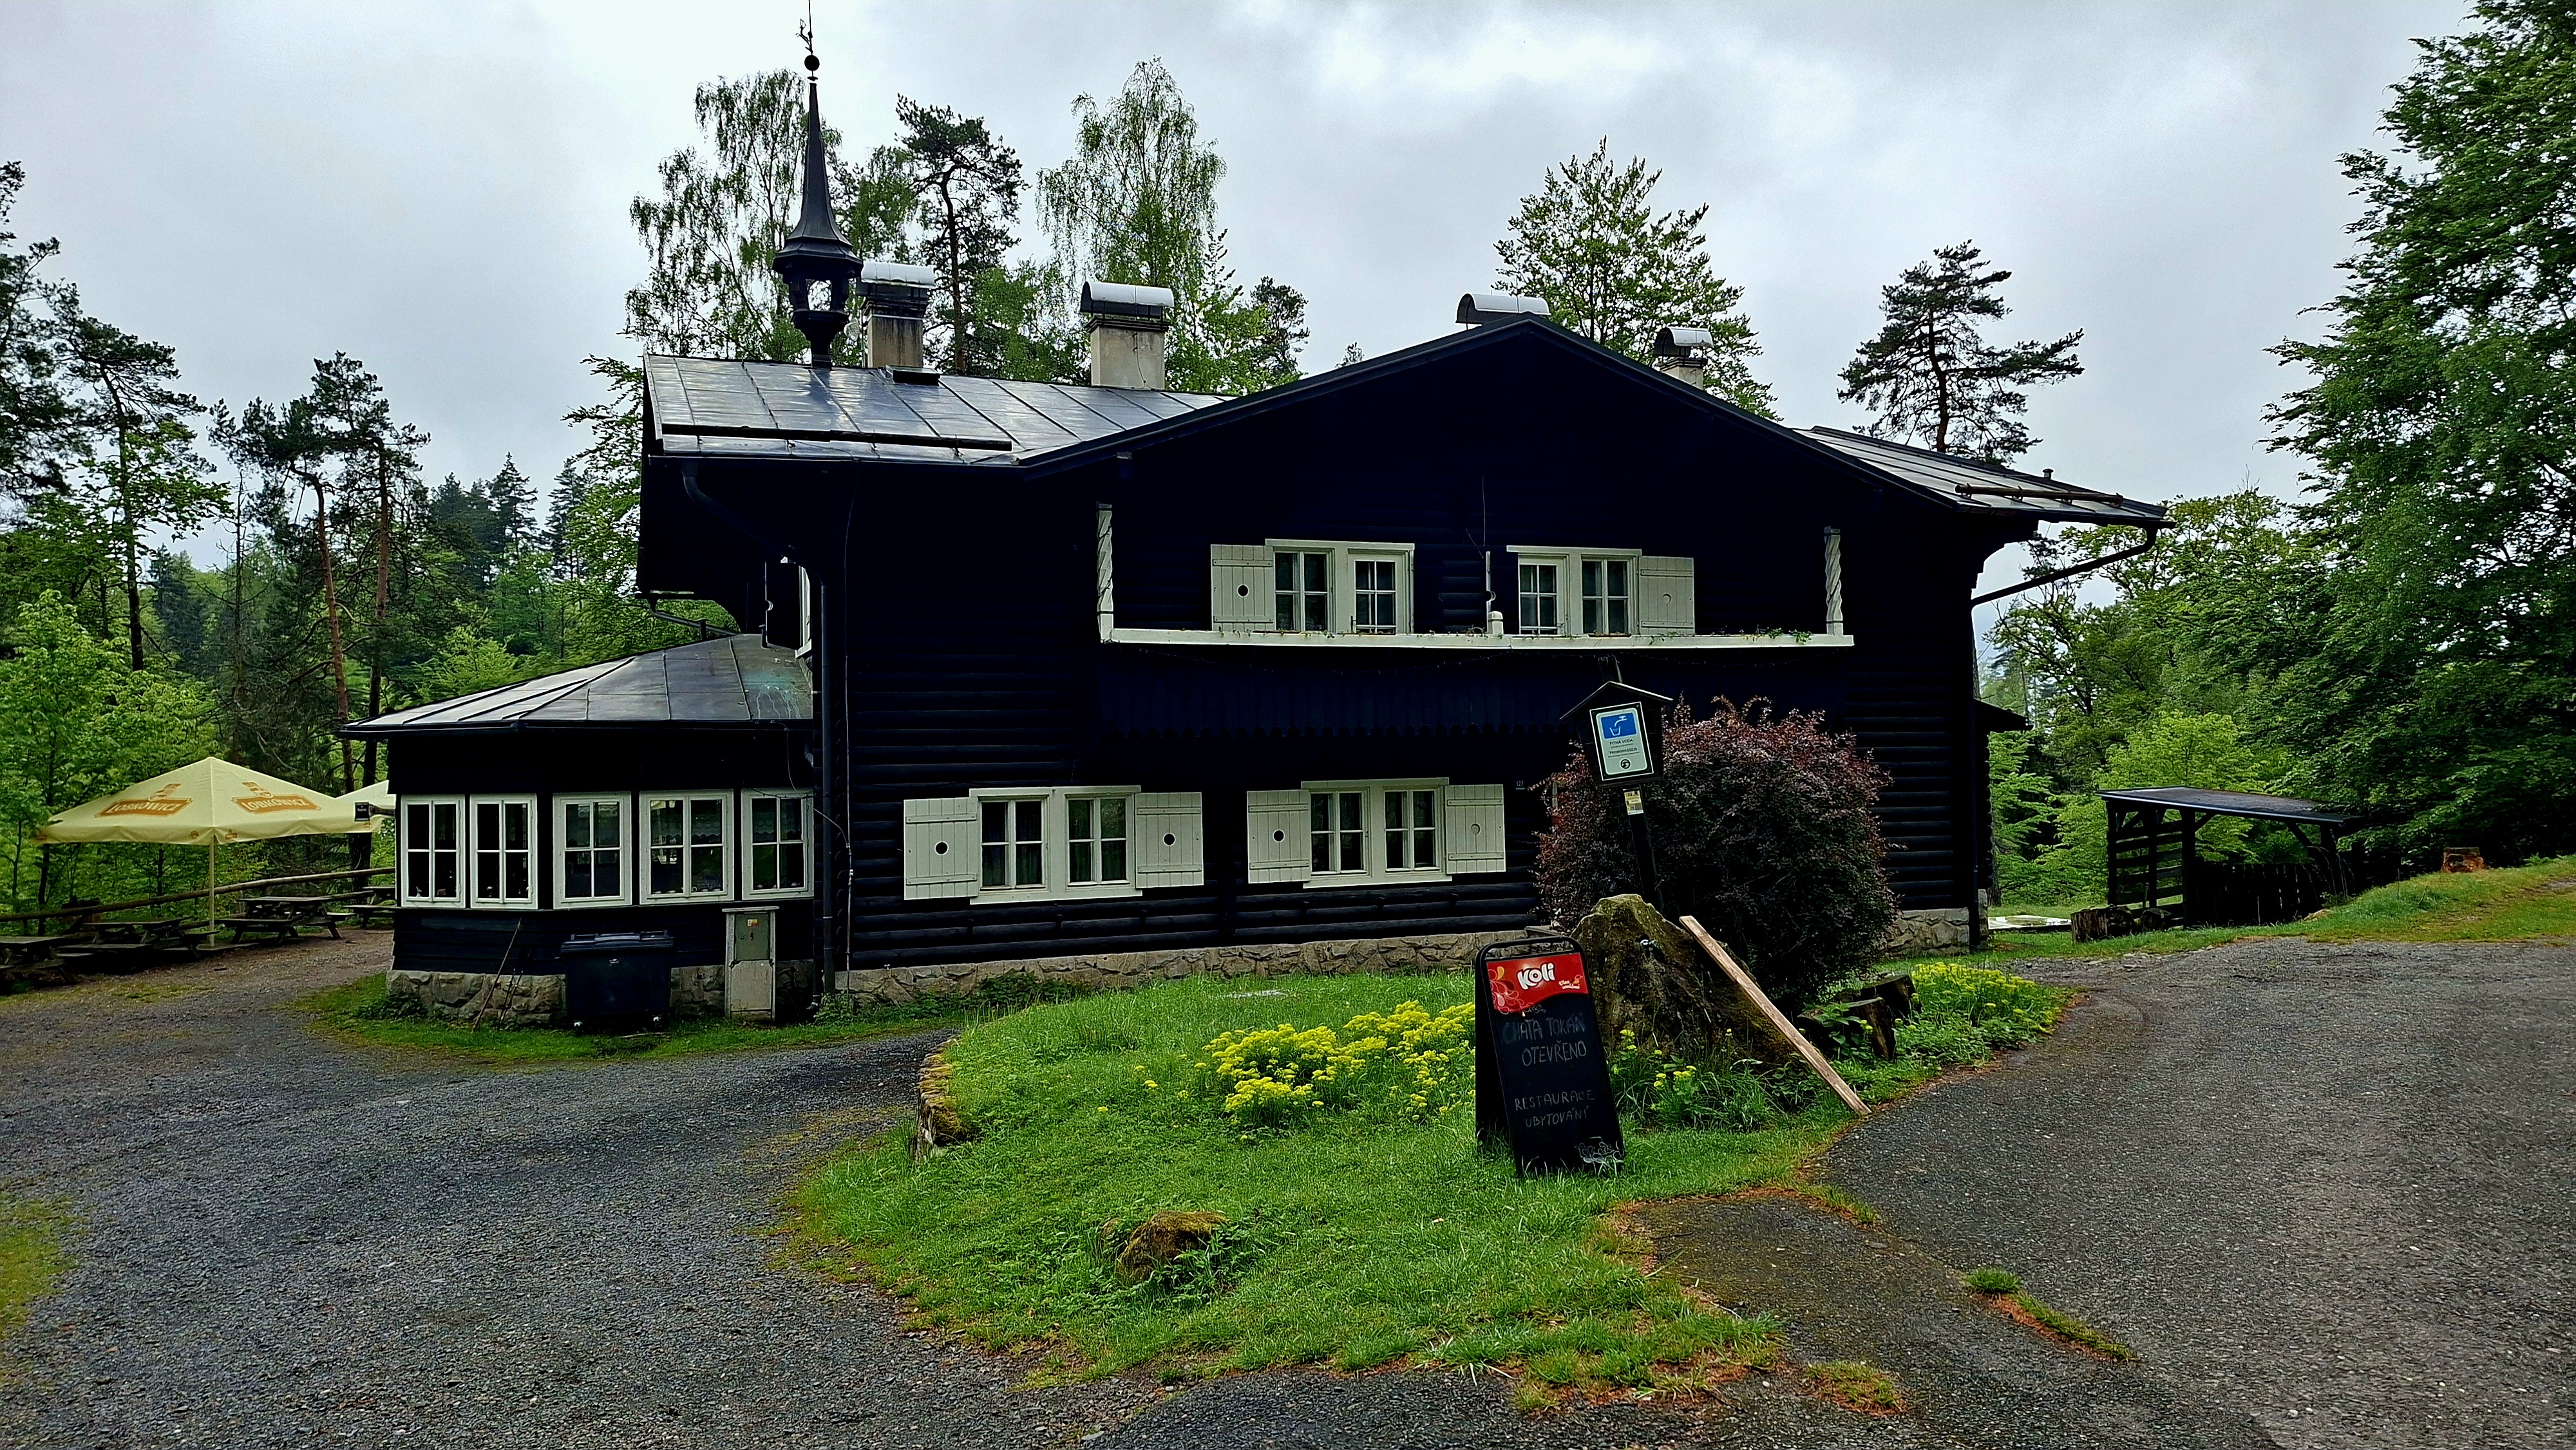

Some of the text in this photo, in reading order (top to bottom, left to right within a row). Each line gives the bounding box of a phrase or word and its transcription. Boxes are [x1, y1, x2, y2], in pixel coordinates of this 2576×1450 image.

[242, 798, 310, 811] LOBKOWICZ
[1517, 963, 1556, 990] Koli
[1502, 1018, 1544, 1045] CHATA
[1521, 1039, 1587, 1067] OTEVŘENO
[1515, 1089, 1596, 1111] RESTAURACE
[1525, 1105, 1590, 1128] UBYTOVÁNÍ
